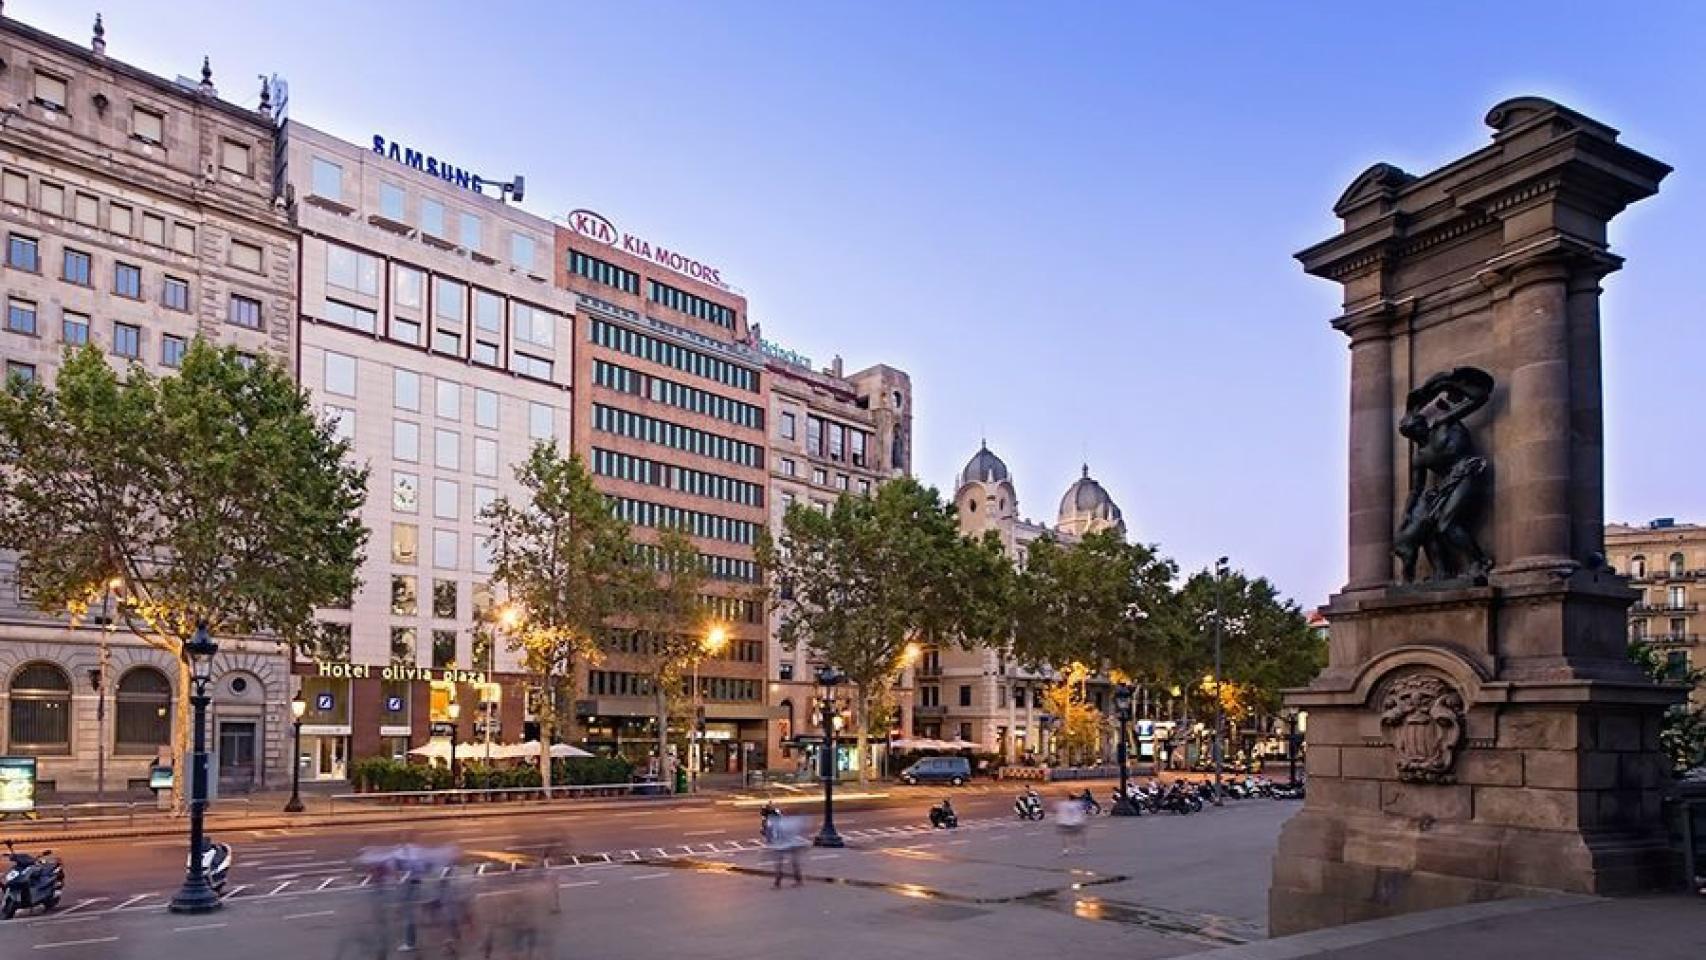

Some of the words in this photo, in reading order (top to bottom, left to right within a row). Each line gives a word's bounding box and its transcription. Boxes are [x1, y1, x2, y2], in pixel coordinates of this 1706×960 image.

[373, 134, 482, 194] SAMSUNG
[575, 212, 611, 242] KIA
[623, 232, 651, 257] KIA
[655, 246, 721, 285] MOTORS
[320, 662, 370, 678] Hotel
[382, 664, 433, 680] olivia
